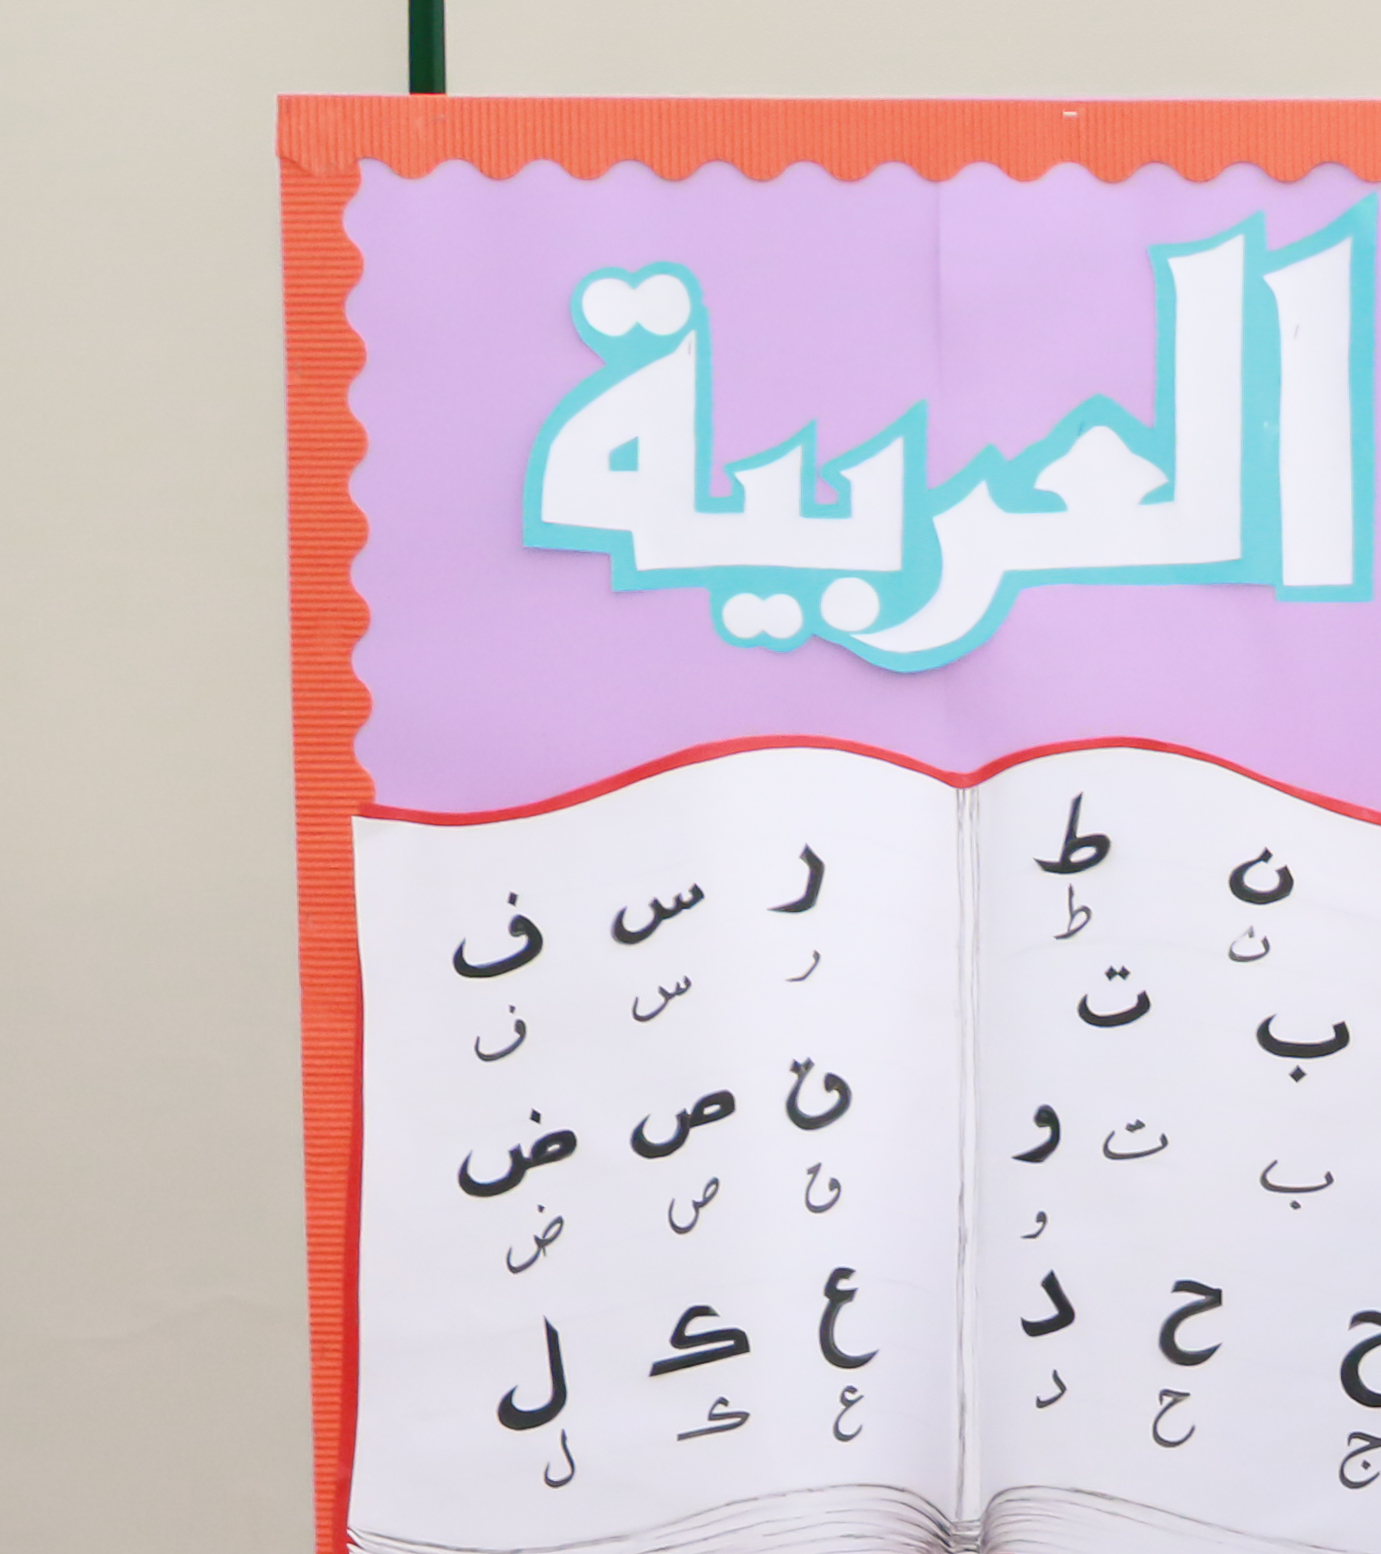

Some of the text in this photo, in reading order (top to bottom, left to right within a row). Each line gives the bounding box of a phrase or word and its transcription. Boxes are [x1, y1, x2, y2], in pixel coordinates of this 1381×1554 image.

[523, 192, 1377, 672] العربية
[1035, 793, 1110, 874] ط
[771, 845, 824, 913] ر
[1229, 848, 1294, 905] ن
[453, 893, 543, 978] ف
[612, 884, 704, 945] س
[1055, 885, 1091, 939] ط
[787, 950, 821, 982] ر
[1229, 925, 1270, 962] ن
[632, 976, 692, 1023] س
[1078, 966, 1151, 1028] ت
[475, 1005, 527, 1062] ف
[1256, 1014, 1350, 1082] ب
[457, 1109, 578, 1198] ض
[631, 1089, 736, 1159] ص
[1012, 1105, 1061, 1163] و
[1102, 1119, 1169, 1161] ت
[669, 1177, 720, 1234] ص
[1260, 1158, 1334, 1210] ب
[506, 1206, 564, 1274] ض
[1021, 1211, 1048, 1240] و
[818, 1267, 878, 1369] ع
[1021, 1270, 1076, 1338] د
[1158, 1279, 1223, 1366] ح
[649, 1304, 751, 1378] ك
[497, 1318, 568, 1431] ل
[1036, 1369, 1067, 1409] د
[676, 1396, 751, 1442] ك
[833, 1385, 864, 1442] ع
[1152, 1388, 1196, 1449] ح
[544, 1430, 576, 1489] ل
